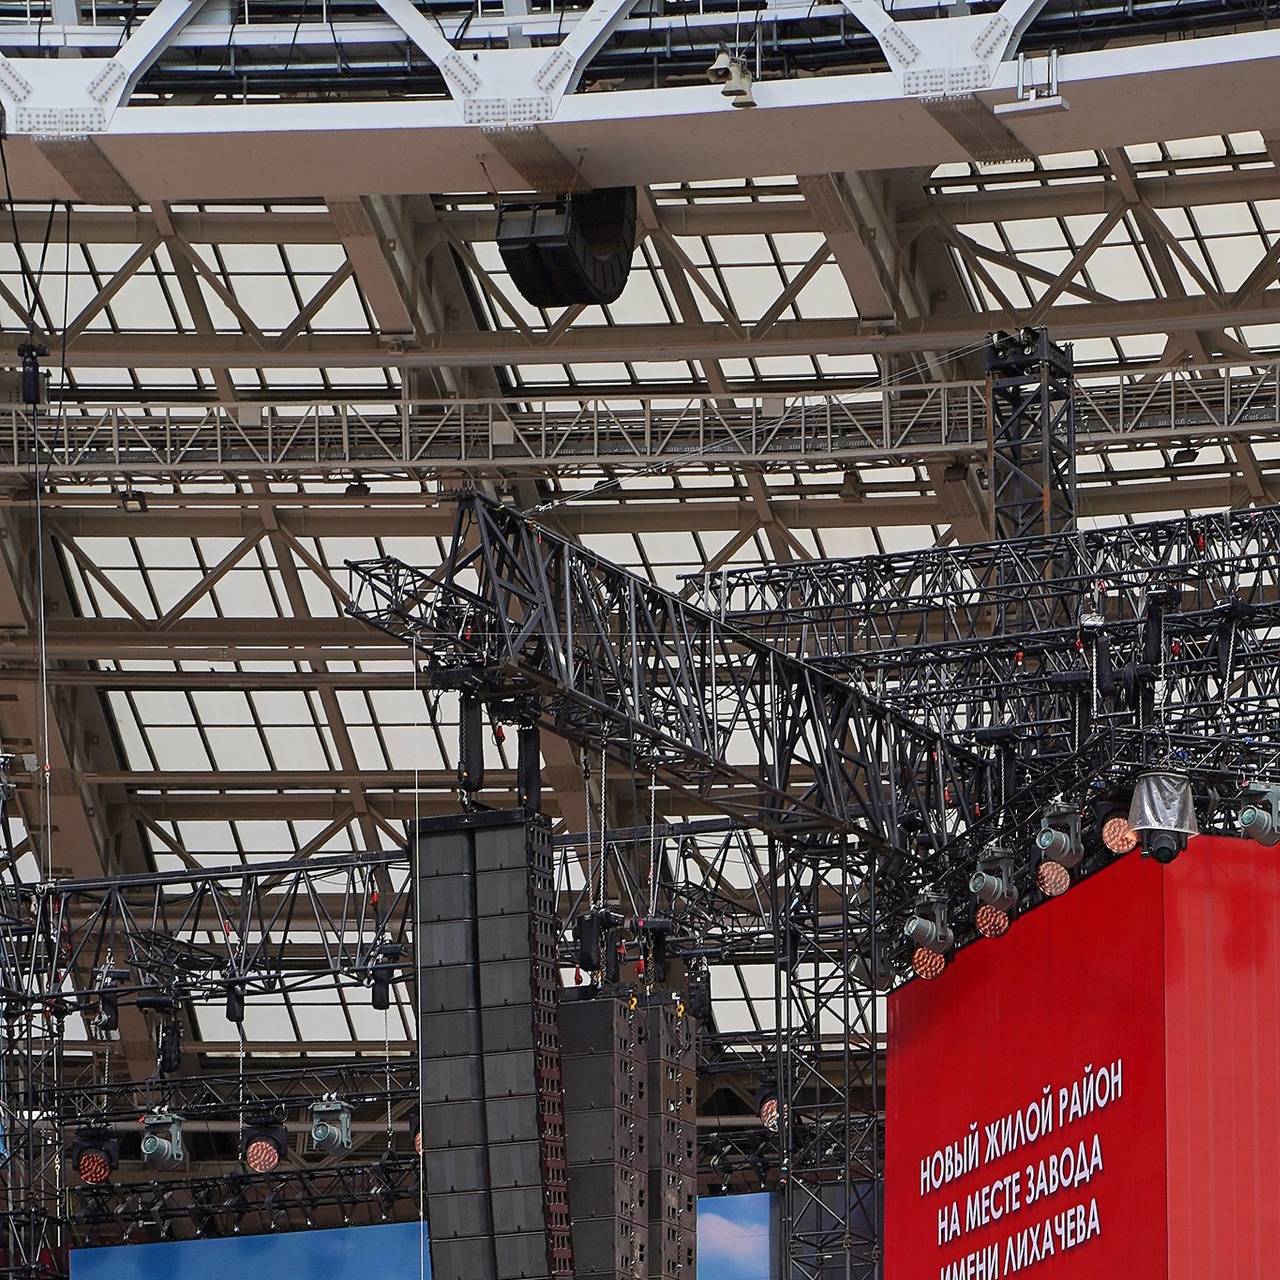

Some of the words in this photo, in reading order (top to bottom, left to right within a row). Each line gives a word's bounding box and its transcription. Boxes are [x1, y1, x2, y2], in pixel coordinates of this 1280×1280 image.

[920, 1121, 979, 1196] НОВЫЙ
[985, 1084, 1053, 1164] ЖИЛОЙ
[1059, 1058, 1122, 1128] РАЙОН
[938, 1201, 961, 1246] НА
[965, 1171, 1021, 1233] МЕСТЕ
[1025, 1133, 1103, 1205] ЗАВОДА
[1003, 1198, 1101, 1276] ЛИХАЧЕВА
